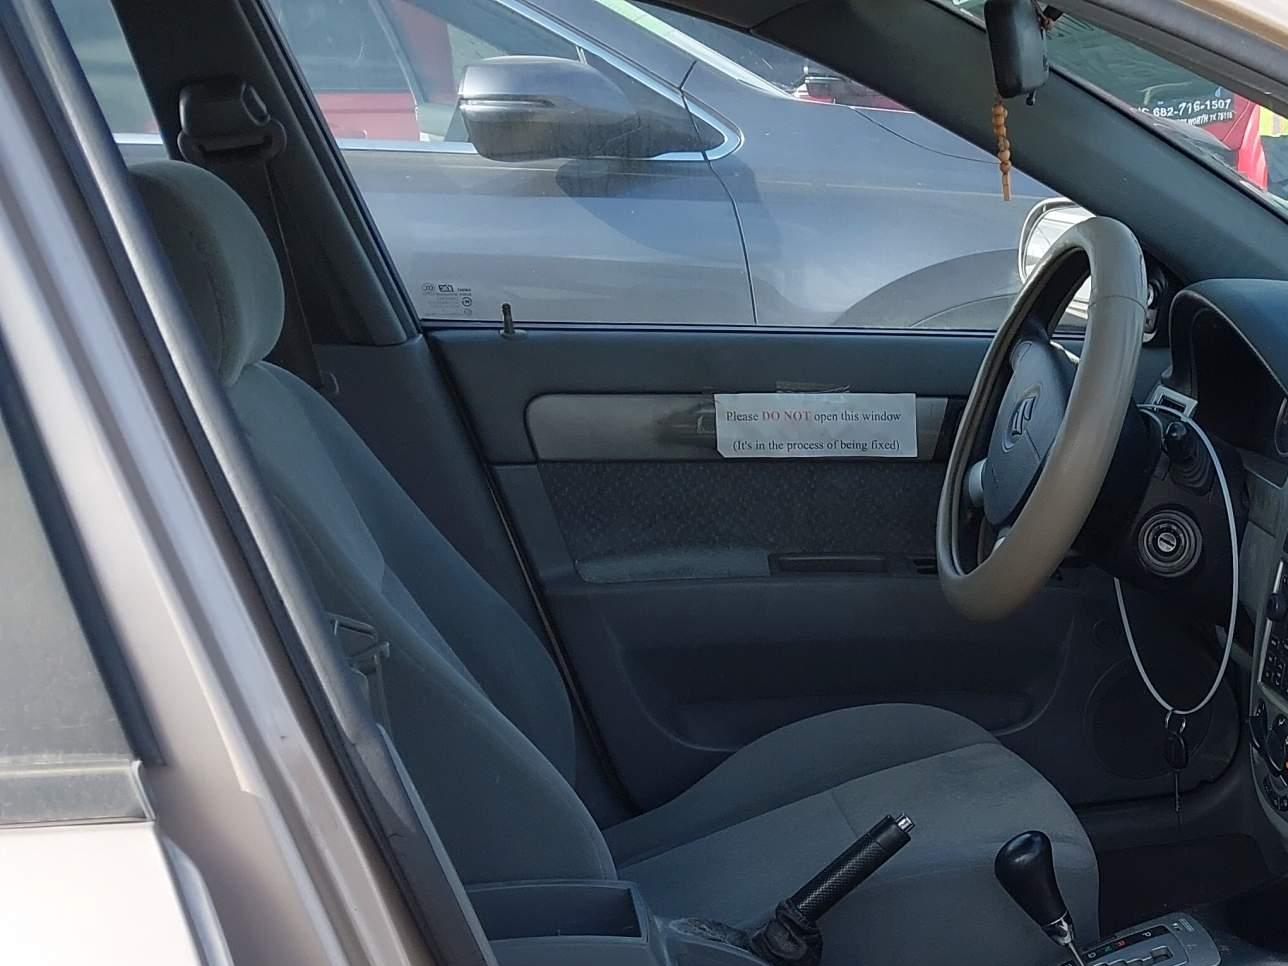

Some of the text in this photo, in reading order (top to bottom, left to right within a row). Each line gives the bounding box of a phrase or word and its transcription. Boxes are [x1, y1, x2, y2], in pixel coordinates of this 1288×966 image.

[1153, 98, 1232, 117] 682-716-1507
[726, 410, 902, 424] Please DO NOT open this window
[732, 439, 900, 453] (It's in the process of being fixed)
